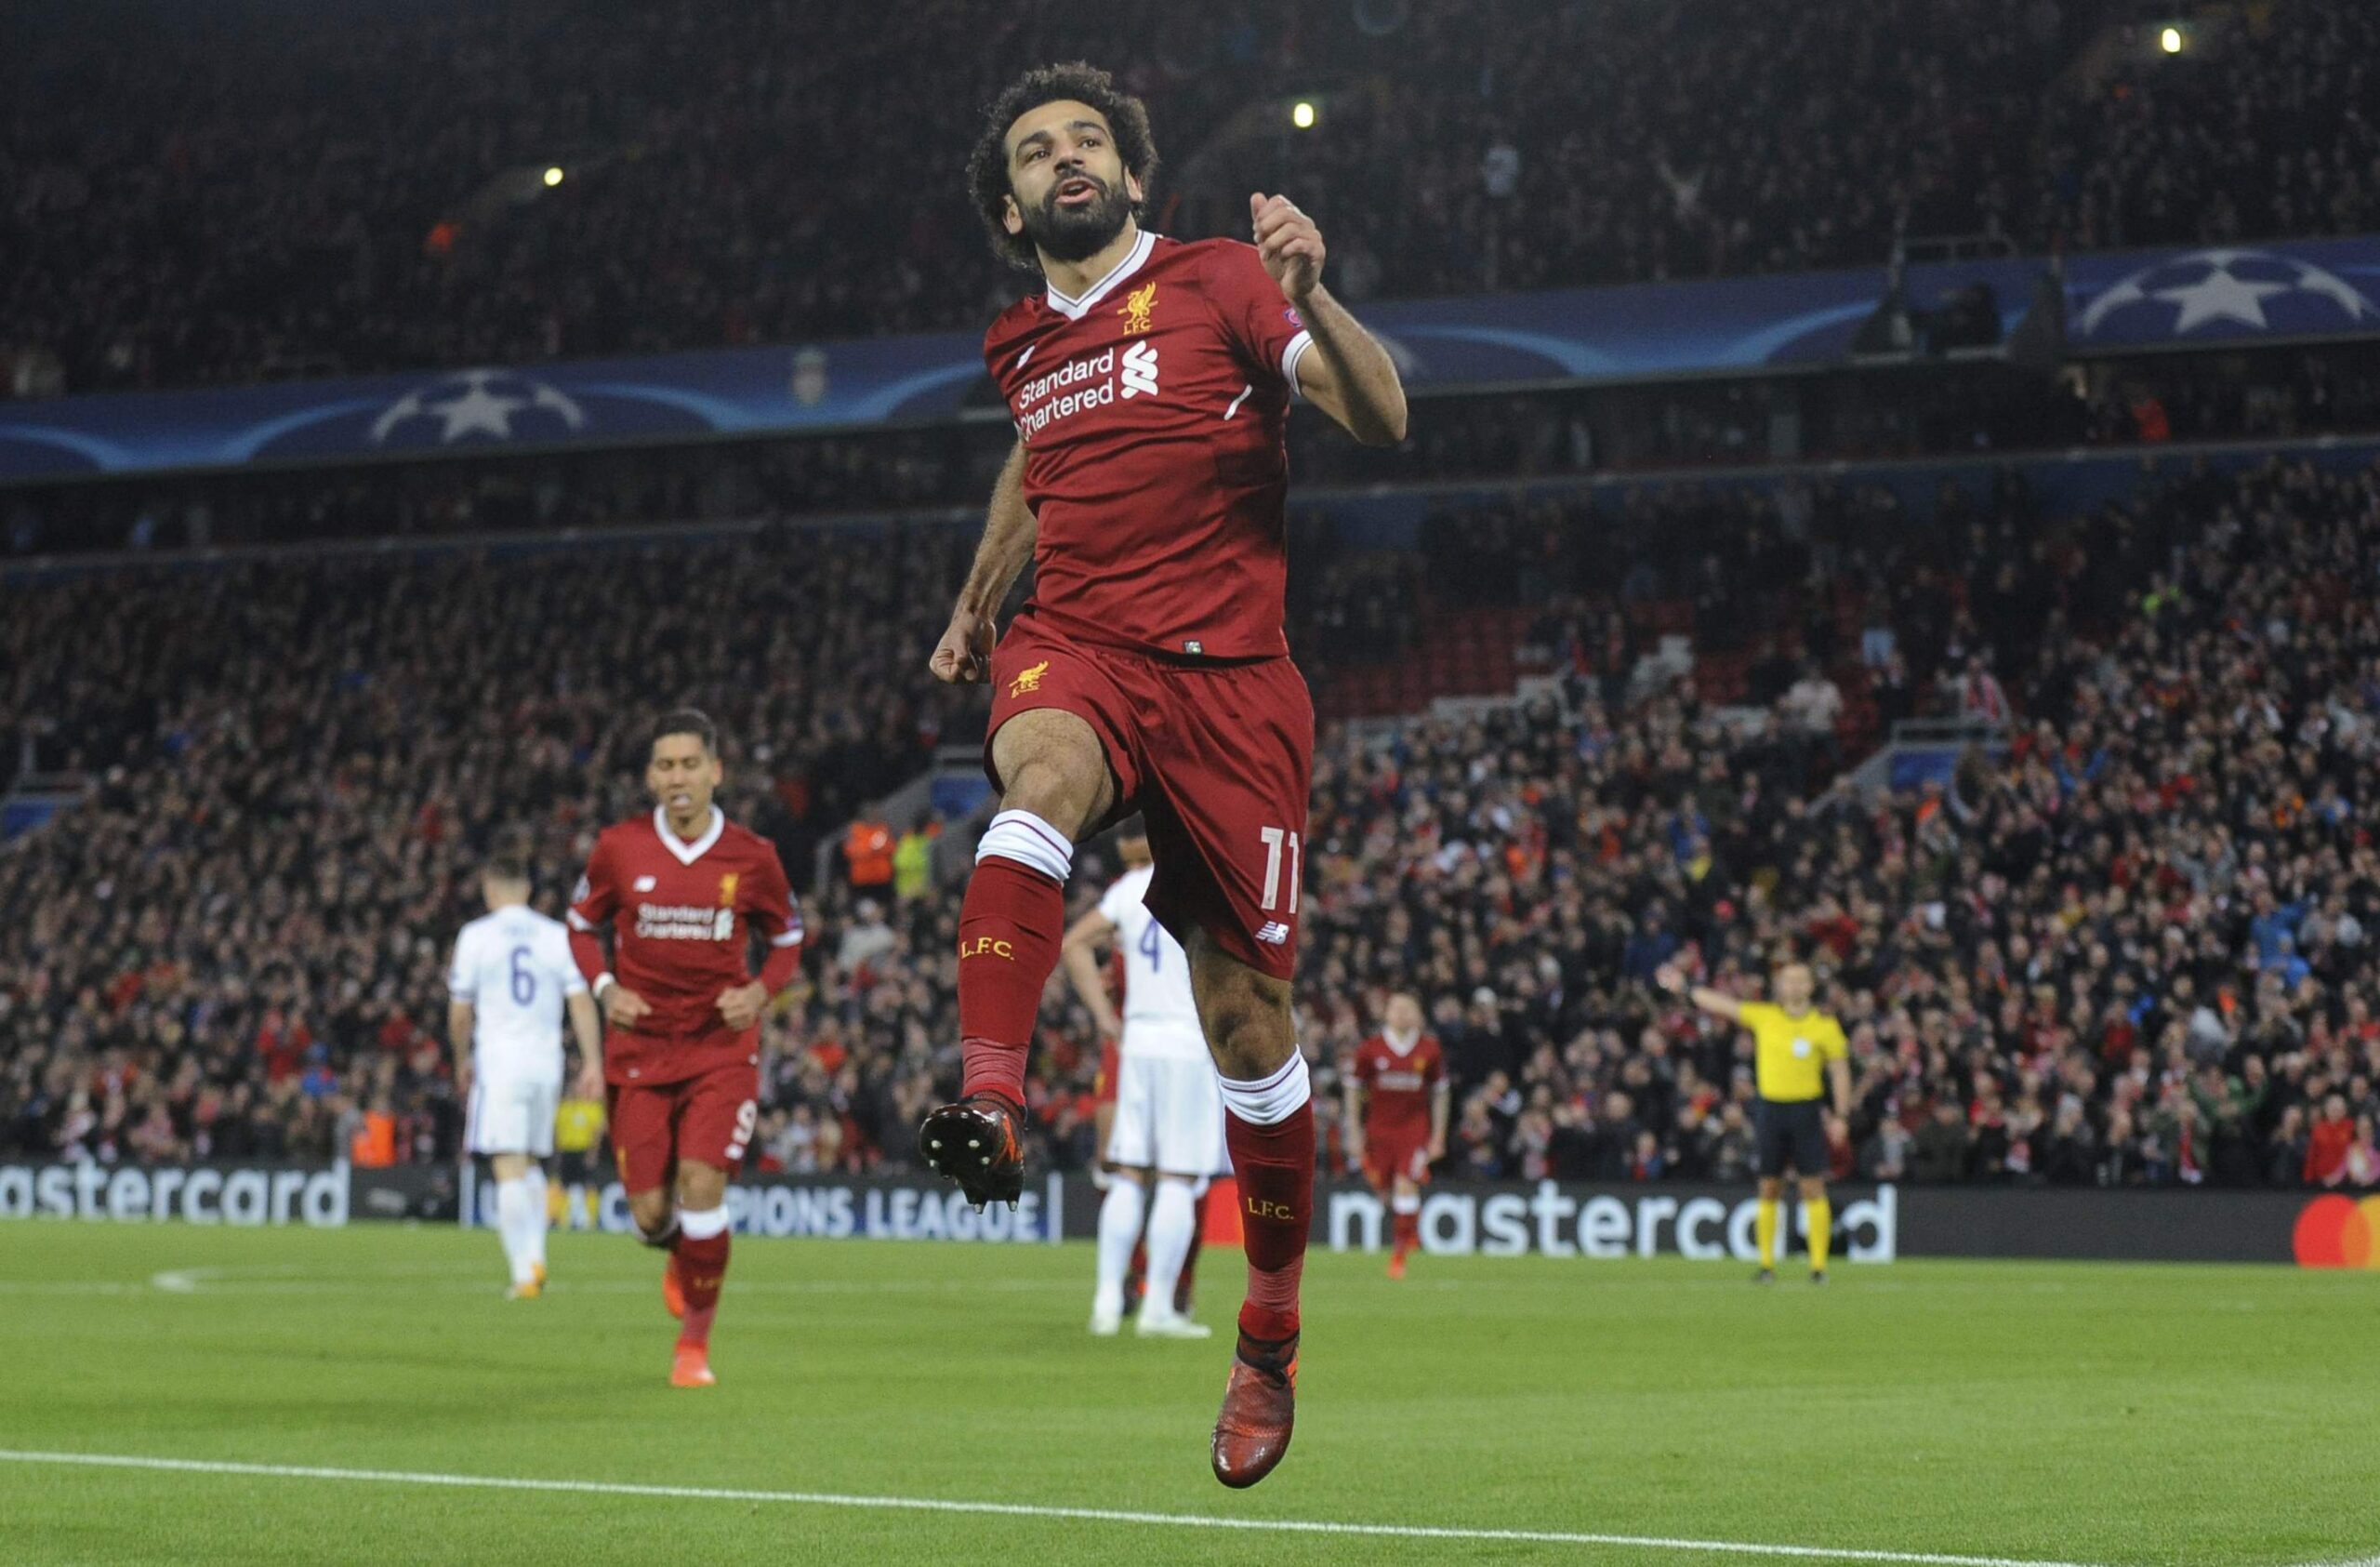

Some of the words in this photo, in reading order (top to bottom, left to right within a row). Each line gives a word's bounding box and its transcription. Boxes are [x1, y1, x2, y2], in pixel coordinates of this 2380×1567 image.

[1124, 318, 1151, 335] LFC
[1019, 347, 1114, 409] Standard
[1020, 377, 1114, 442] Chartered
[1261, 826, 1299, 914] 11
[1140, 916, 1160, 973] 4
[510, 946, 536, 1007] 6
[732, 1099, 758, 1145] 9
[0, 1156, 350, 1227] astercard
[866, 1187, 1039, 1242] LEAGUE
